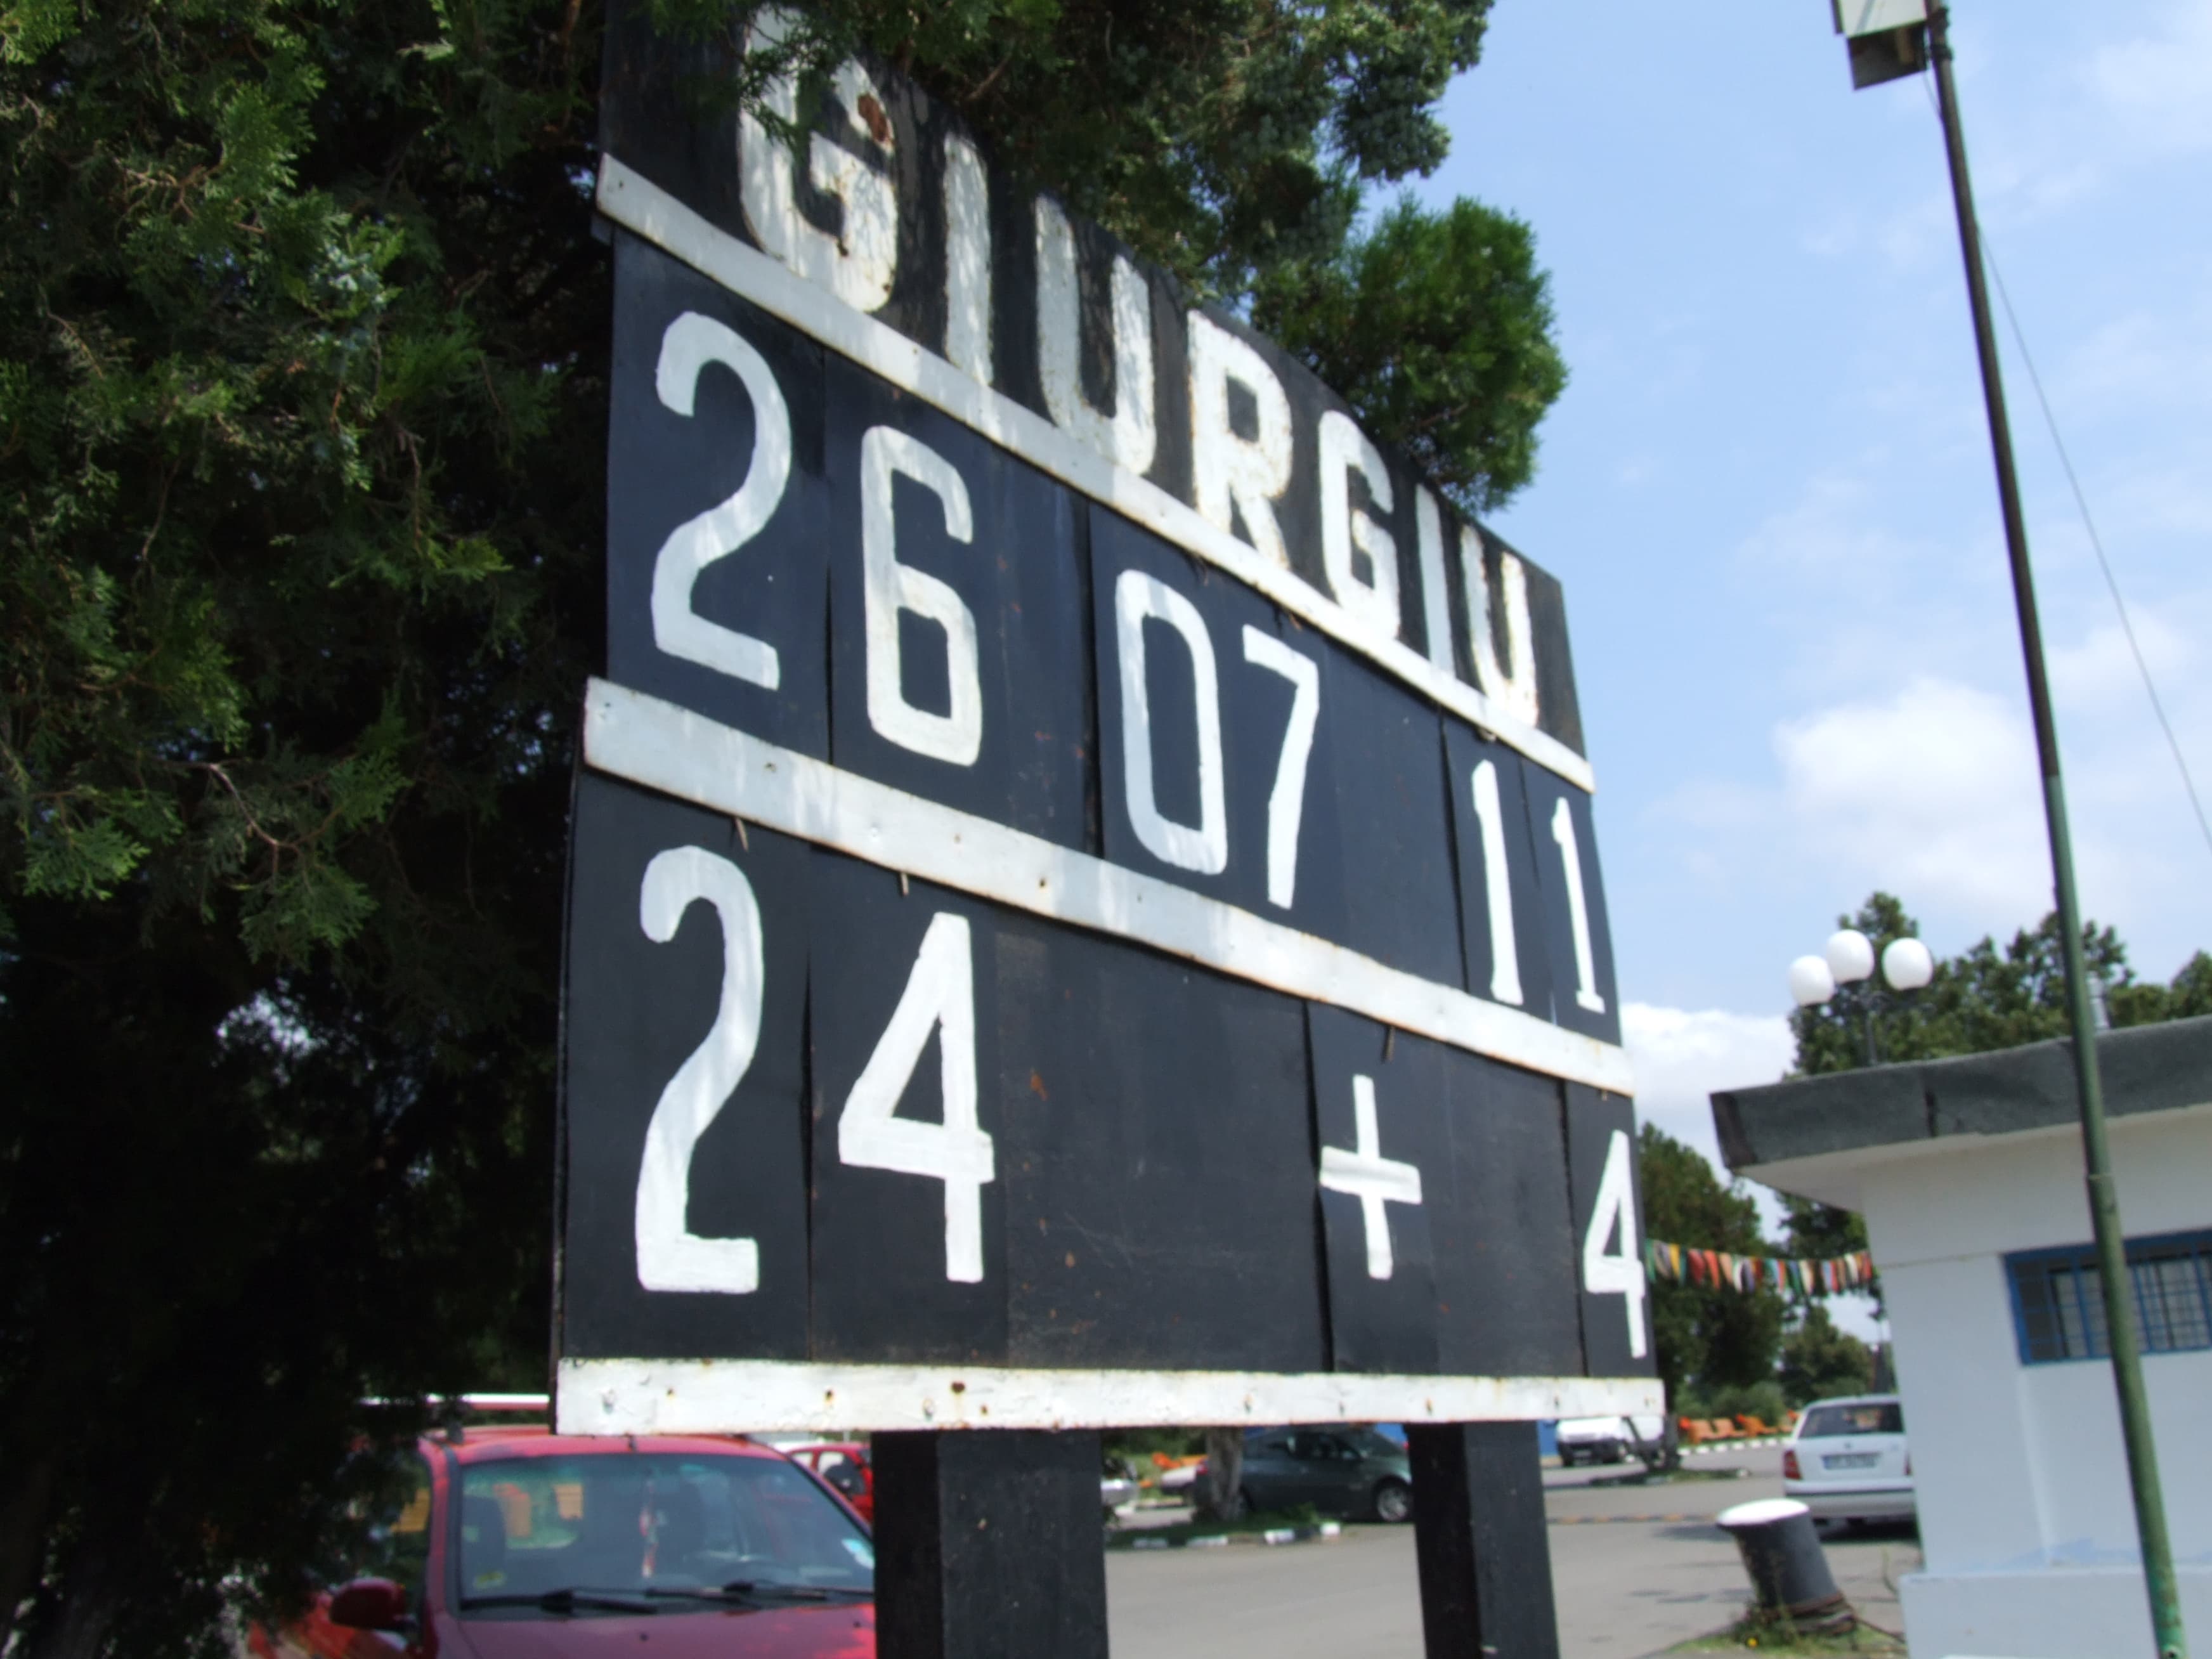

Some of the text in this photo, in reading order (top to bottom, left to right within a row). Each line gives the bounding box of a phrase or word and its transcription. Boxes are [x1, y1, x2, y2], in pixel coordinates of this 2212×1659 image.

[651, 311, 1606, 1015] 26 07 11
[737, 5, 1539, 728] GIURGIU
[635, 845, 995, 1293] 24
